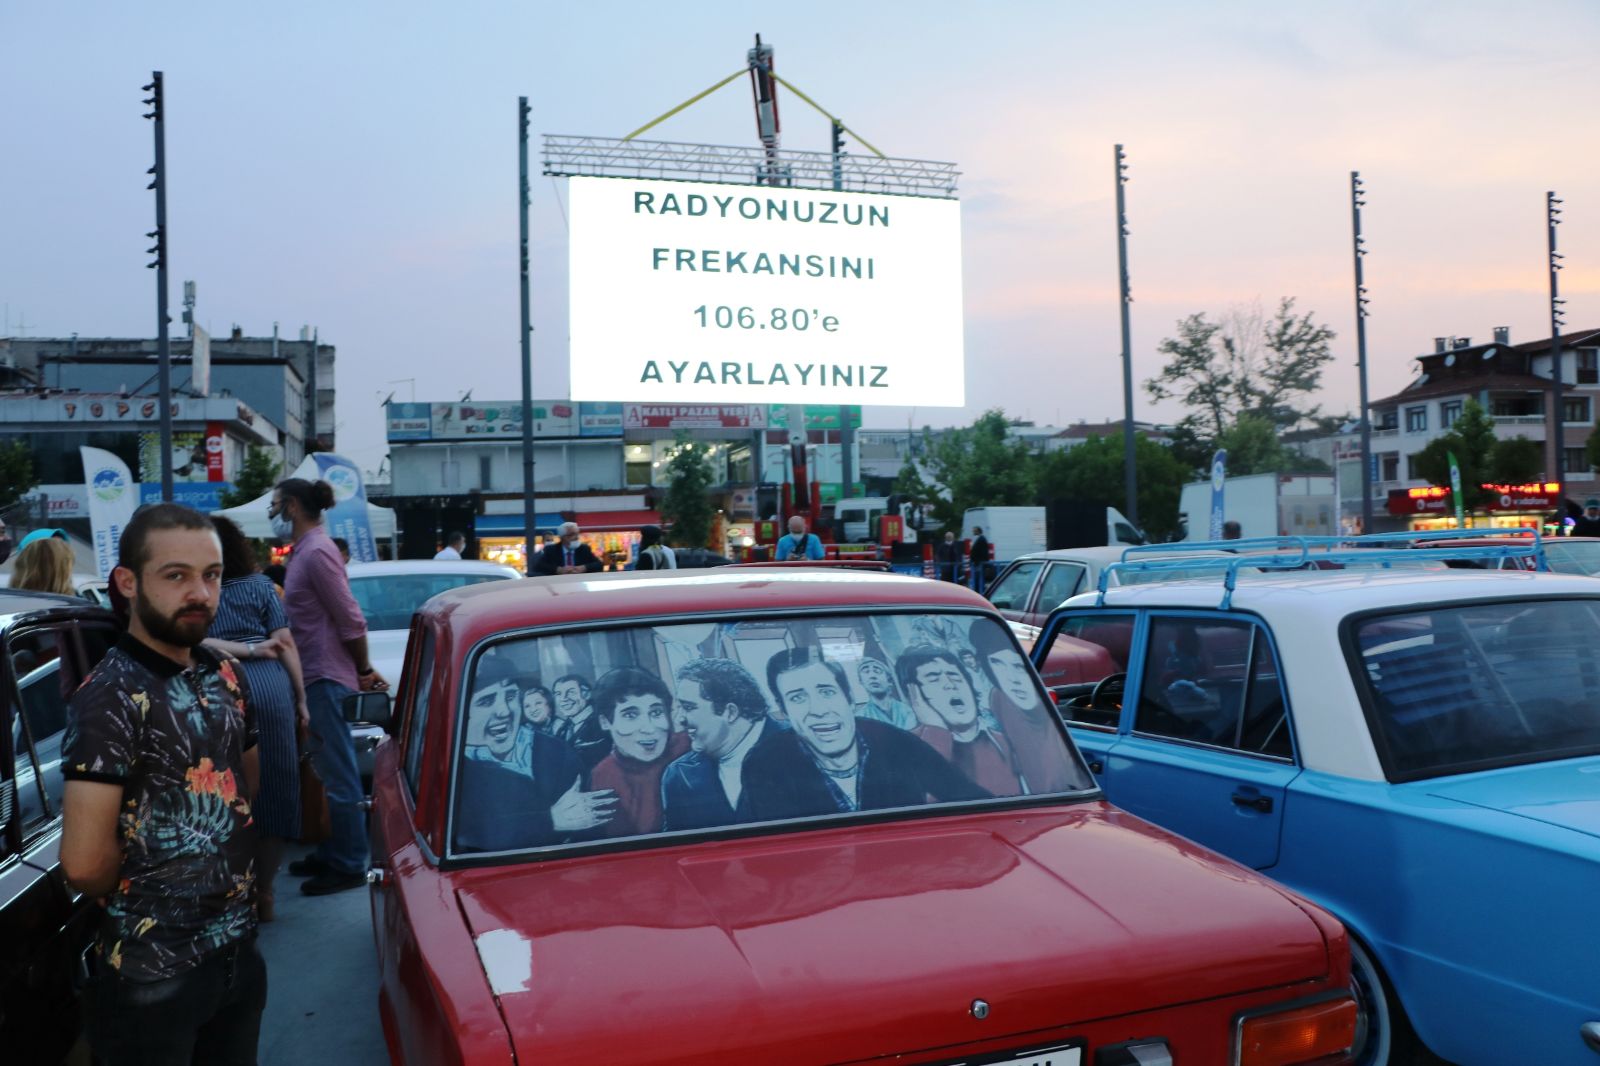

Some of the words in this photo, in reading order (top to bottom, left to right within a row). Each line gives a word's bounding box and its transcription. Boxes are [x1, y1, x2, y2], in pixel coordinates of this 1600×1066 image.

[635, 192, 889, 227] RADYONUZUN
[653, 248, 874, 279] FREKANSINI
[640, 361, 889, 387] AYARLAYINIZ
[680, 406, 719, 417] PAZAR
